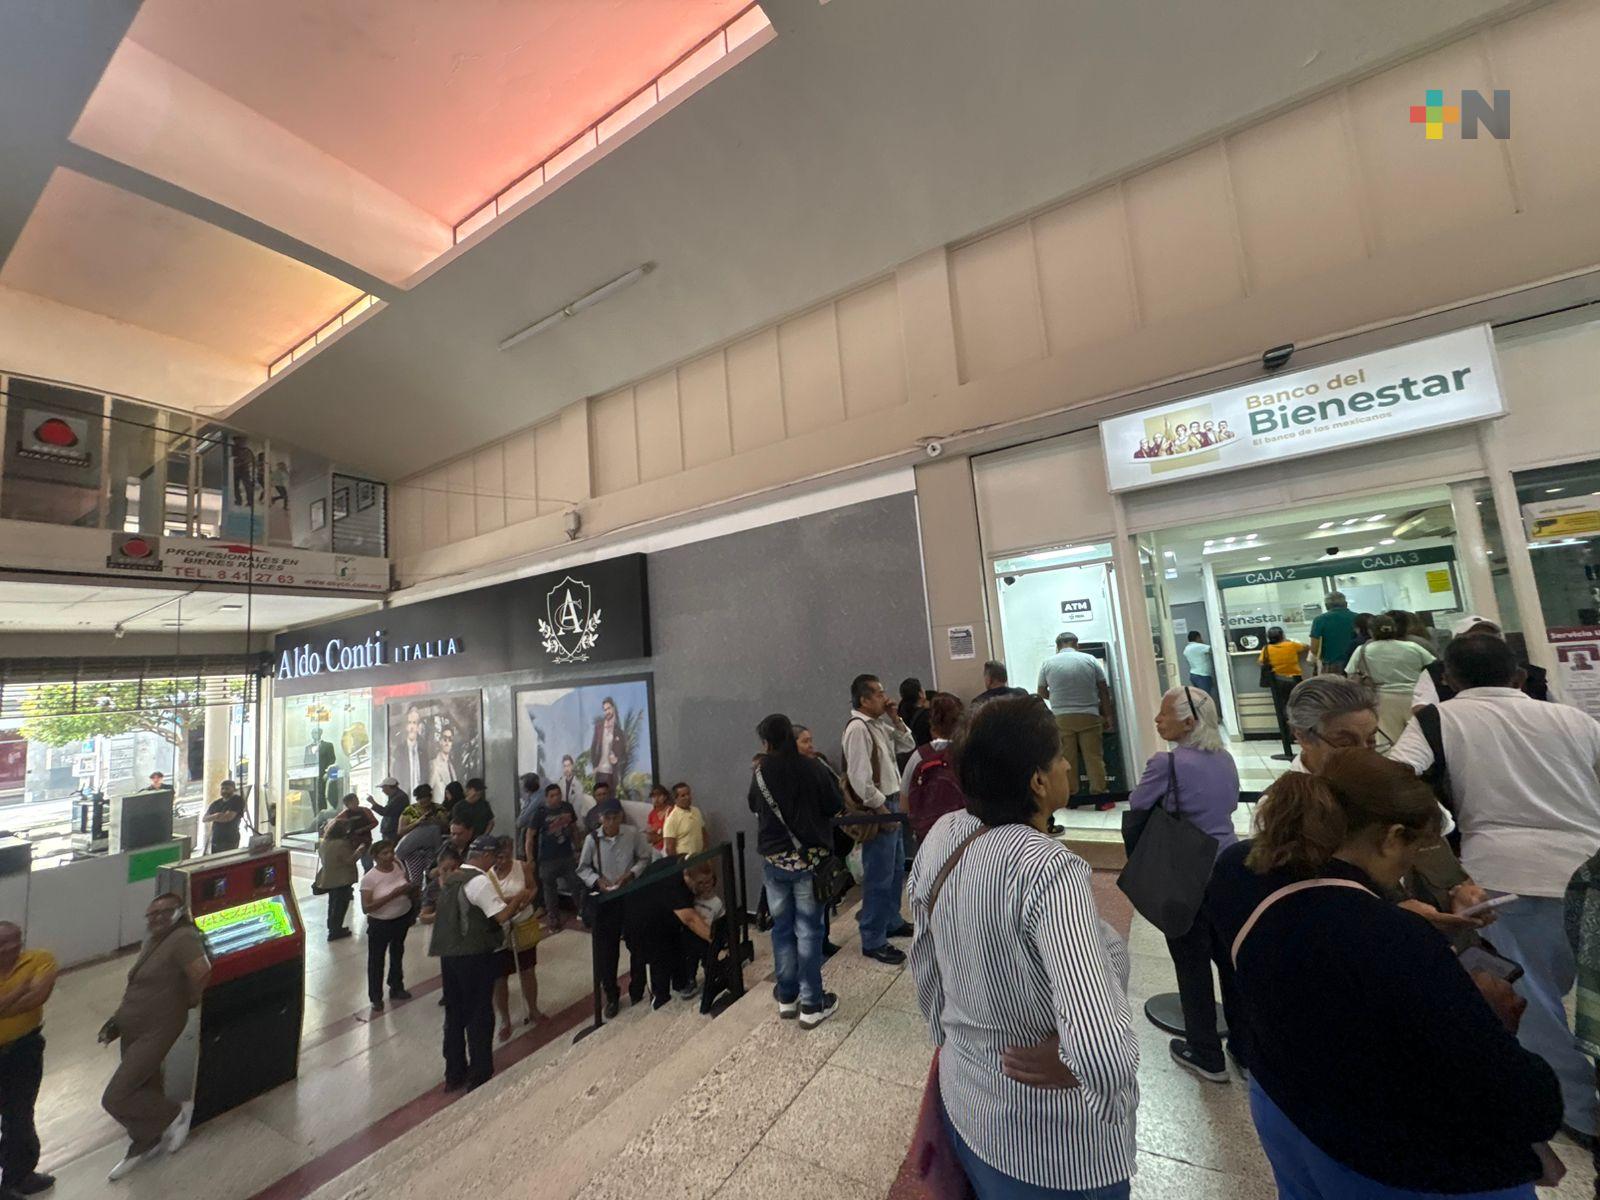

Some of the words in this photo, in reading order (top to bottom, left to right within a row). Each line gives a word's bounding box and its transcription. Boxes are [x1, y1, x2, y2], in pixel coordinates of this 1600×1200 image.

[1246, 382, 1319, 409] Banco
[1326, 369, 1365, 390] del
[1248, 367, 1471, 435] Bienestar
[1252, 438, 1263, 446] El
[1264, 431, 1296, 443] banco
[1298, 428, 1312, 437] de
[1314, 423, 1331, 433] los
[1332, 411, 1393, 429] mexicanos
[165, 547, 279, 564] PROFESIONALES
[281, 558, 299, 566] EN
[183, 556, 235, 568] BIENES
[1361, 554, 1405, 569] CAJA
[1408, 552, 1419, 563] 3
[172, 566, 212, 579] TEL.
[255, 573, 272, 583] 27
[277, 575, 294, 584] 63
[1245, 571, 1284, 584] CAJA
[1286, 568, 1296, 579] 2
[1064, 600, 1088, 612] ATM
[1220, 613, 1284, 626] enestar
[277, 643, 321, 680] Aldo
[325, 630, 383, 672] Conti
[395, 637, 457, 663] ITALIA
